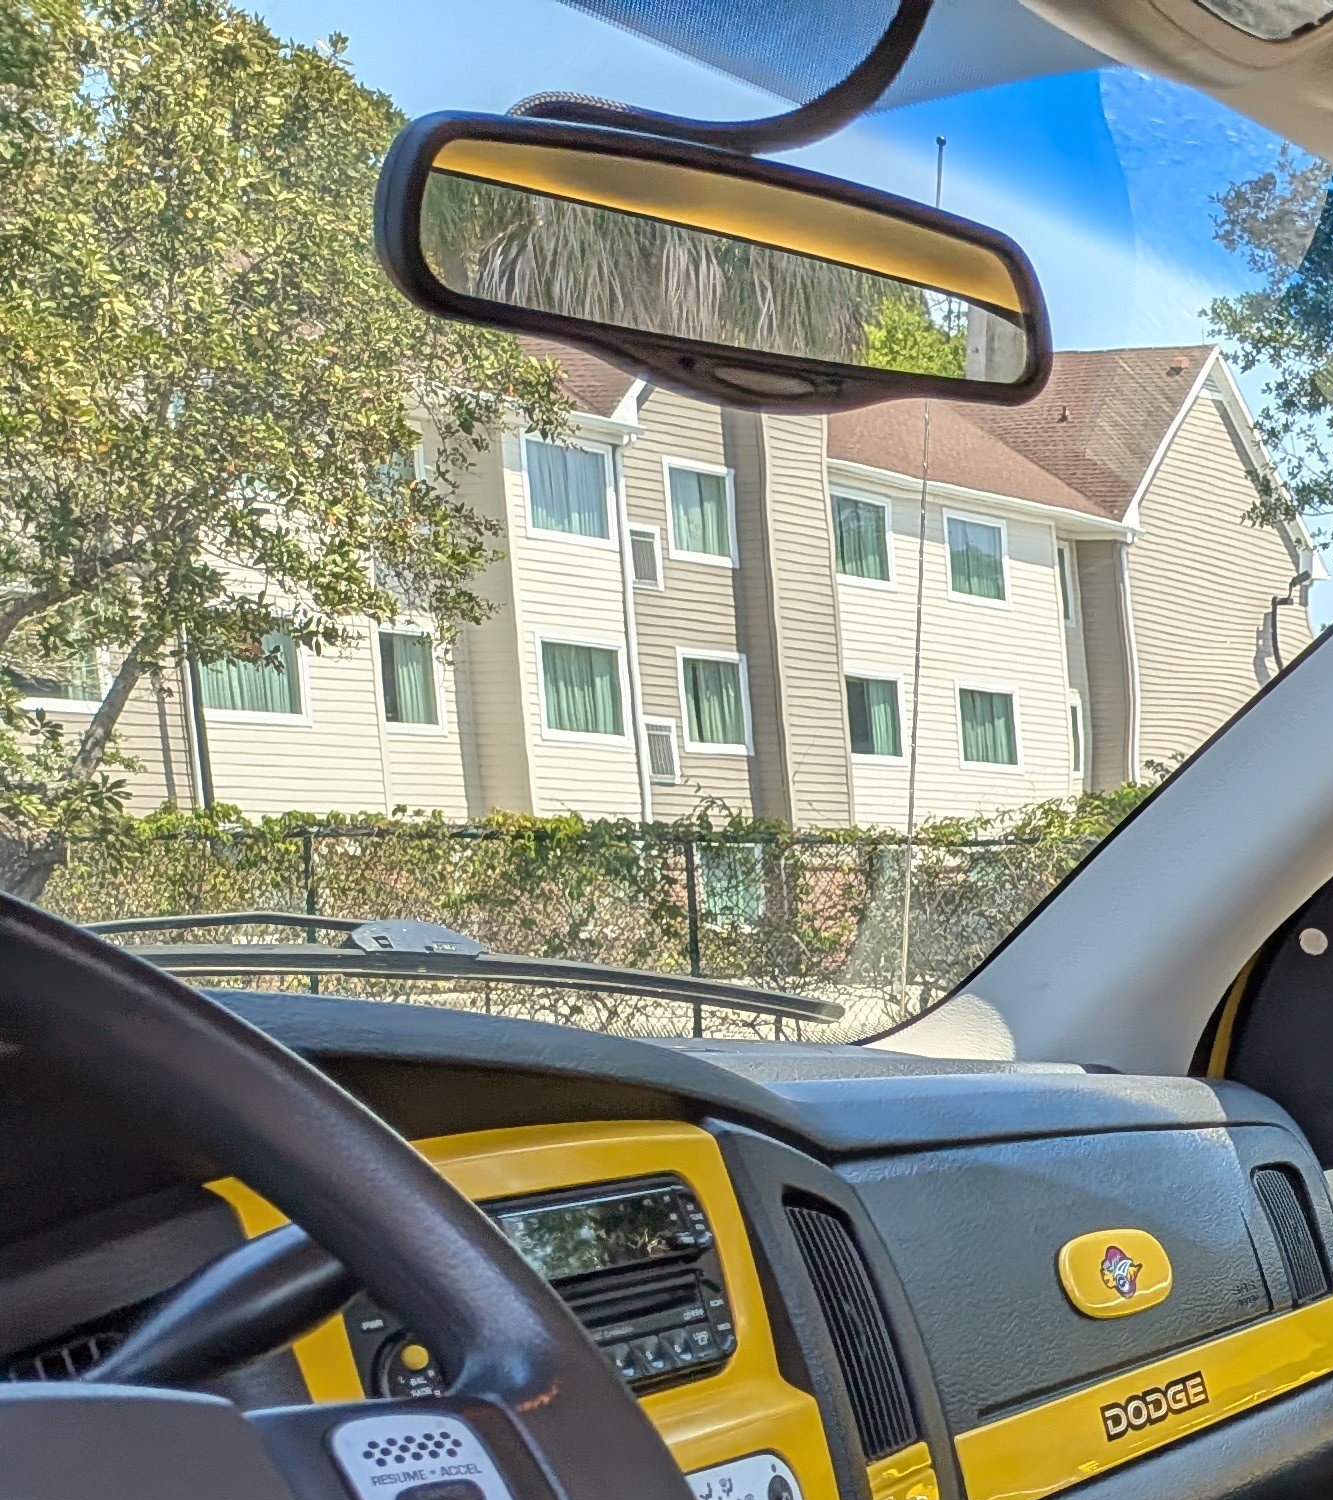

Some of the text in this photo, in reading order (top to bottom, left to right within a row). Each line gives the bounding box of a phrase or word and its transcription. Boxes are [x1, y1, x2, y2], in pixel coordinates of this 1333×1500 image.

[1103, 1376, 1207, 1437] DODGE
[371, 1462, 483, 1488] RESUME ACCEL
